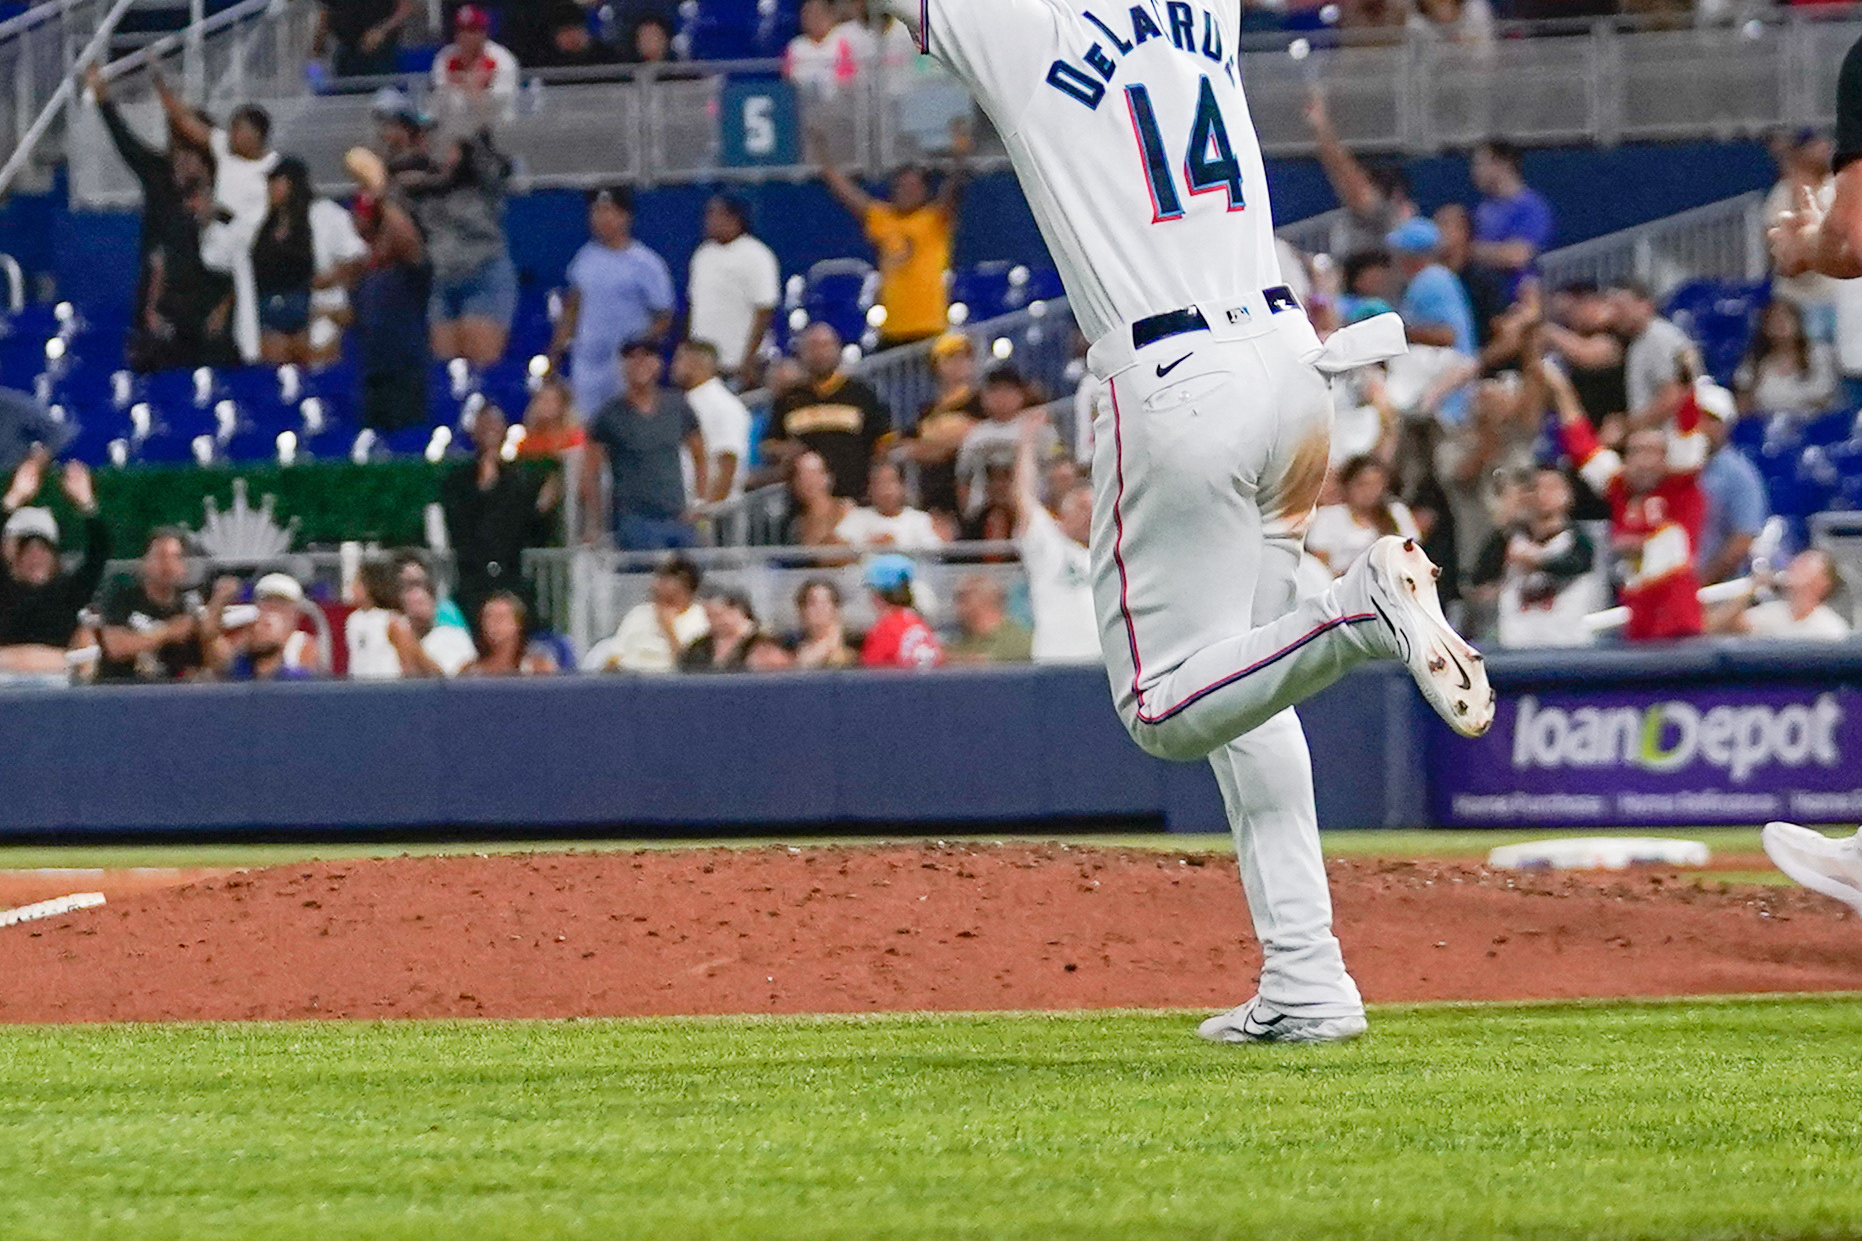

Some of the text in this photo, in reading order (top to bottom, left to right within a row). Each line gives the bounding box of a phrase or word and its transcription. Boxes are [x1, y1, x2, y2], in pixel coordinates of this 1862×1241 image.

[743, 96, 775, 154] 5
[1124, 74, 1246, 224] 14
[1512, 692, 1842, 783] loanDepot
